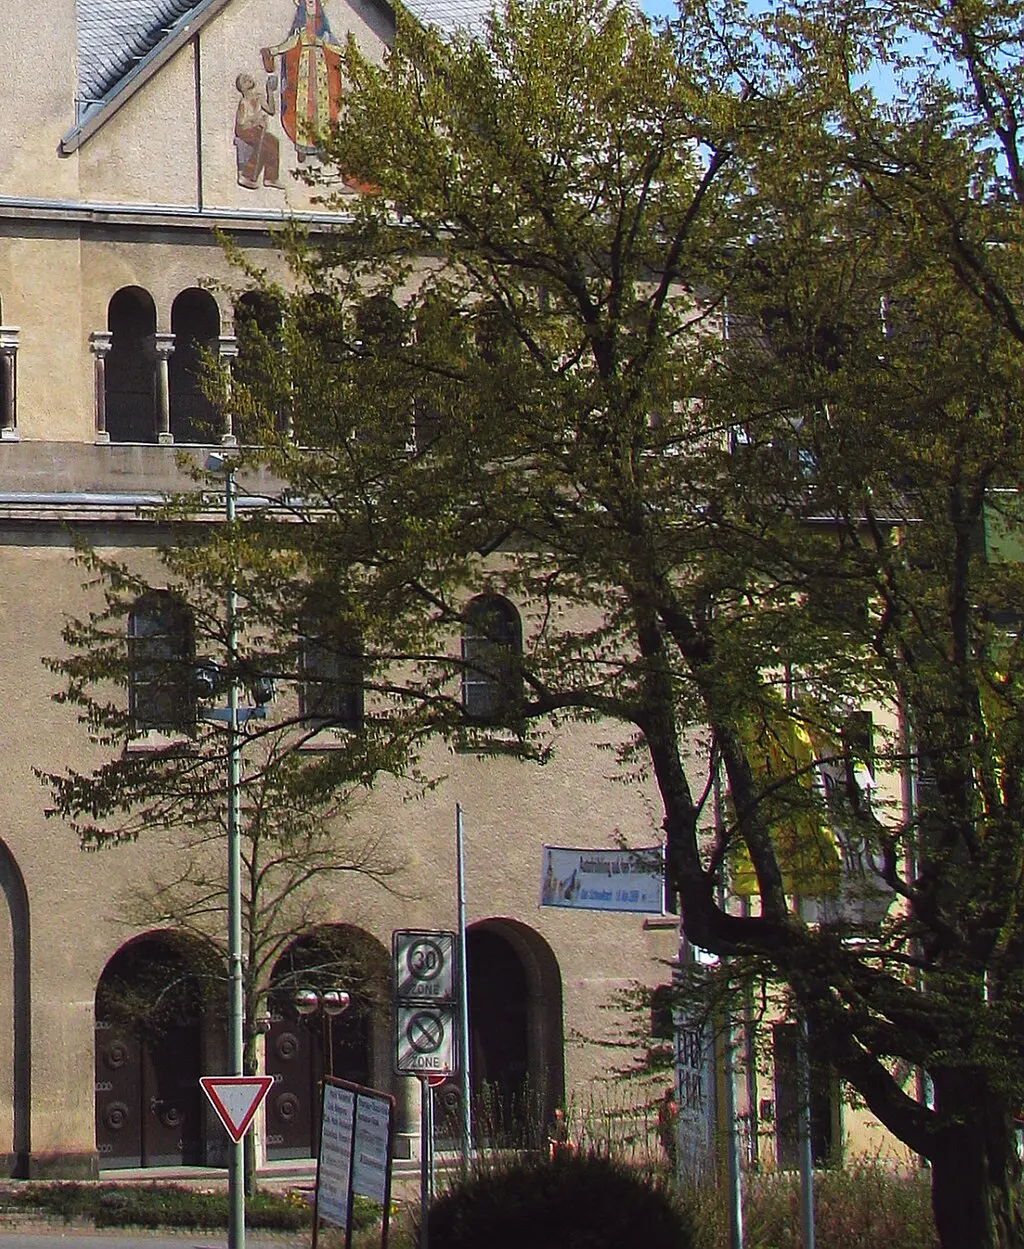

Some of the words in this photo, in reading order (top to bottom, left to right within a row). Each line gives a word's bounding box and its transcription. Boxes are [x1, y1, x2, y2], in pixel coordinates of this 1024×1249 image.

[413, 950, 437, 970] 30
[411, 984, 440, 995] ZONE
[411, 1057, 440, 1068] ZONE
